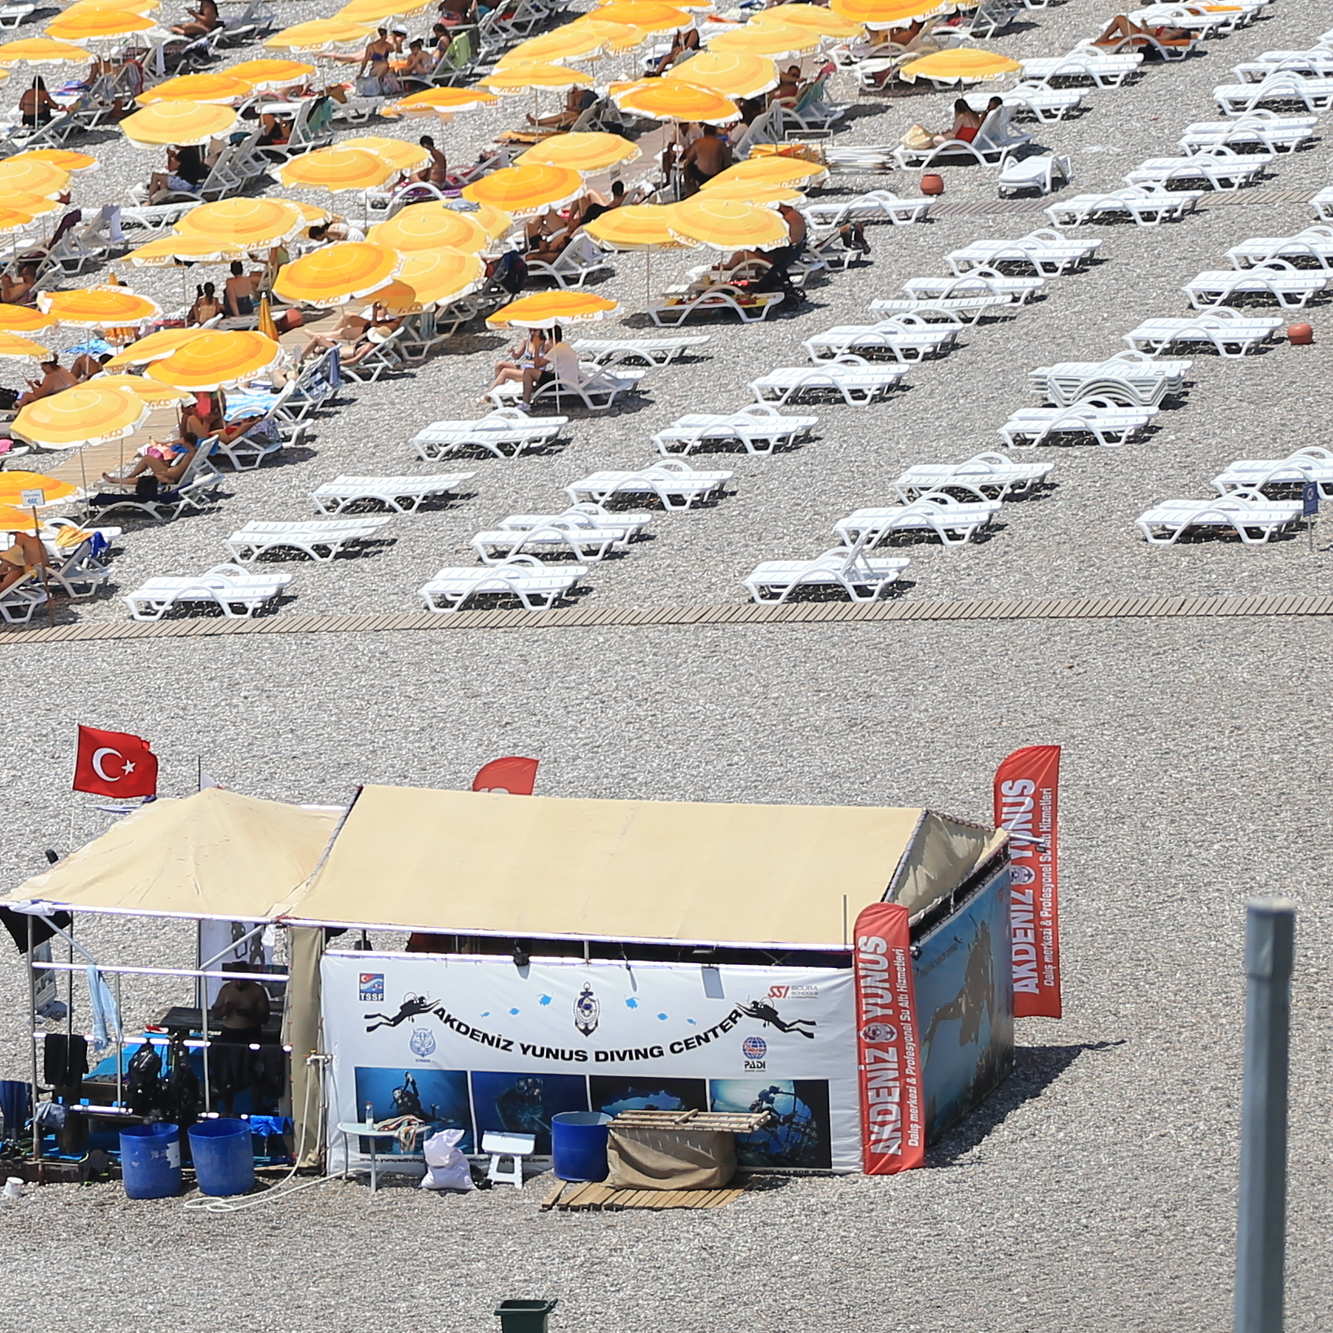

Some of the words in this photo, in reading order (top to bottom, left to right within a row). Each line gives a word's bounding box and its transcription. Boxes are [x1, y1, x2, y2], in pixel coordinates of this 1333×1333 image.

[1039, 788, 1052, 831] Hizmetleri
[1040, 864, 1054, 917] Profesyonel
[1041, 919, 1052, 927] &
[1041, 928, 1053, 963] merkezi
[858, 935, 893, 1021] YUNUS
[892, 949, 907, 993] Hizmetleri
[360, 993, 384, 1001] TSSF
[901, 1010, 912, 1021] Su
[432, 1006, 514, 1052] AKDENİZ
[519, 1042, 588, 1062] YUNUS
[594, 1045, 664, 1062] DIVING
[669, 1009, 742, 1055] CENTER
[903, 1023, 919, 1075] Profesyonel
[744, 1061, 766, 1069] PADI
[907, 1077, 916, 1085] &
[906, 1086, 918, 1122] merkezi
